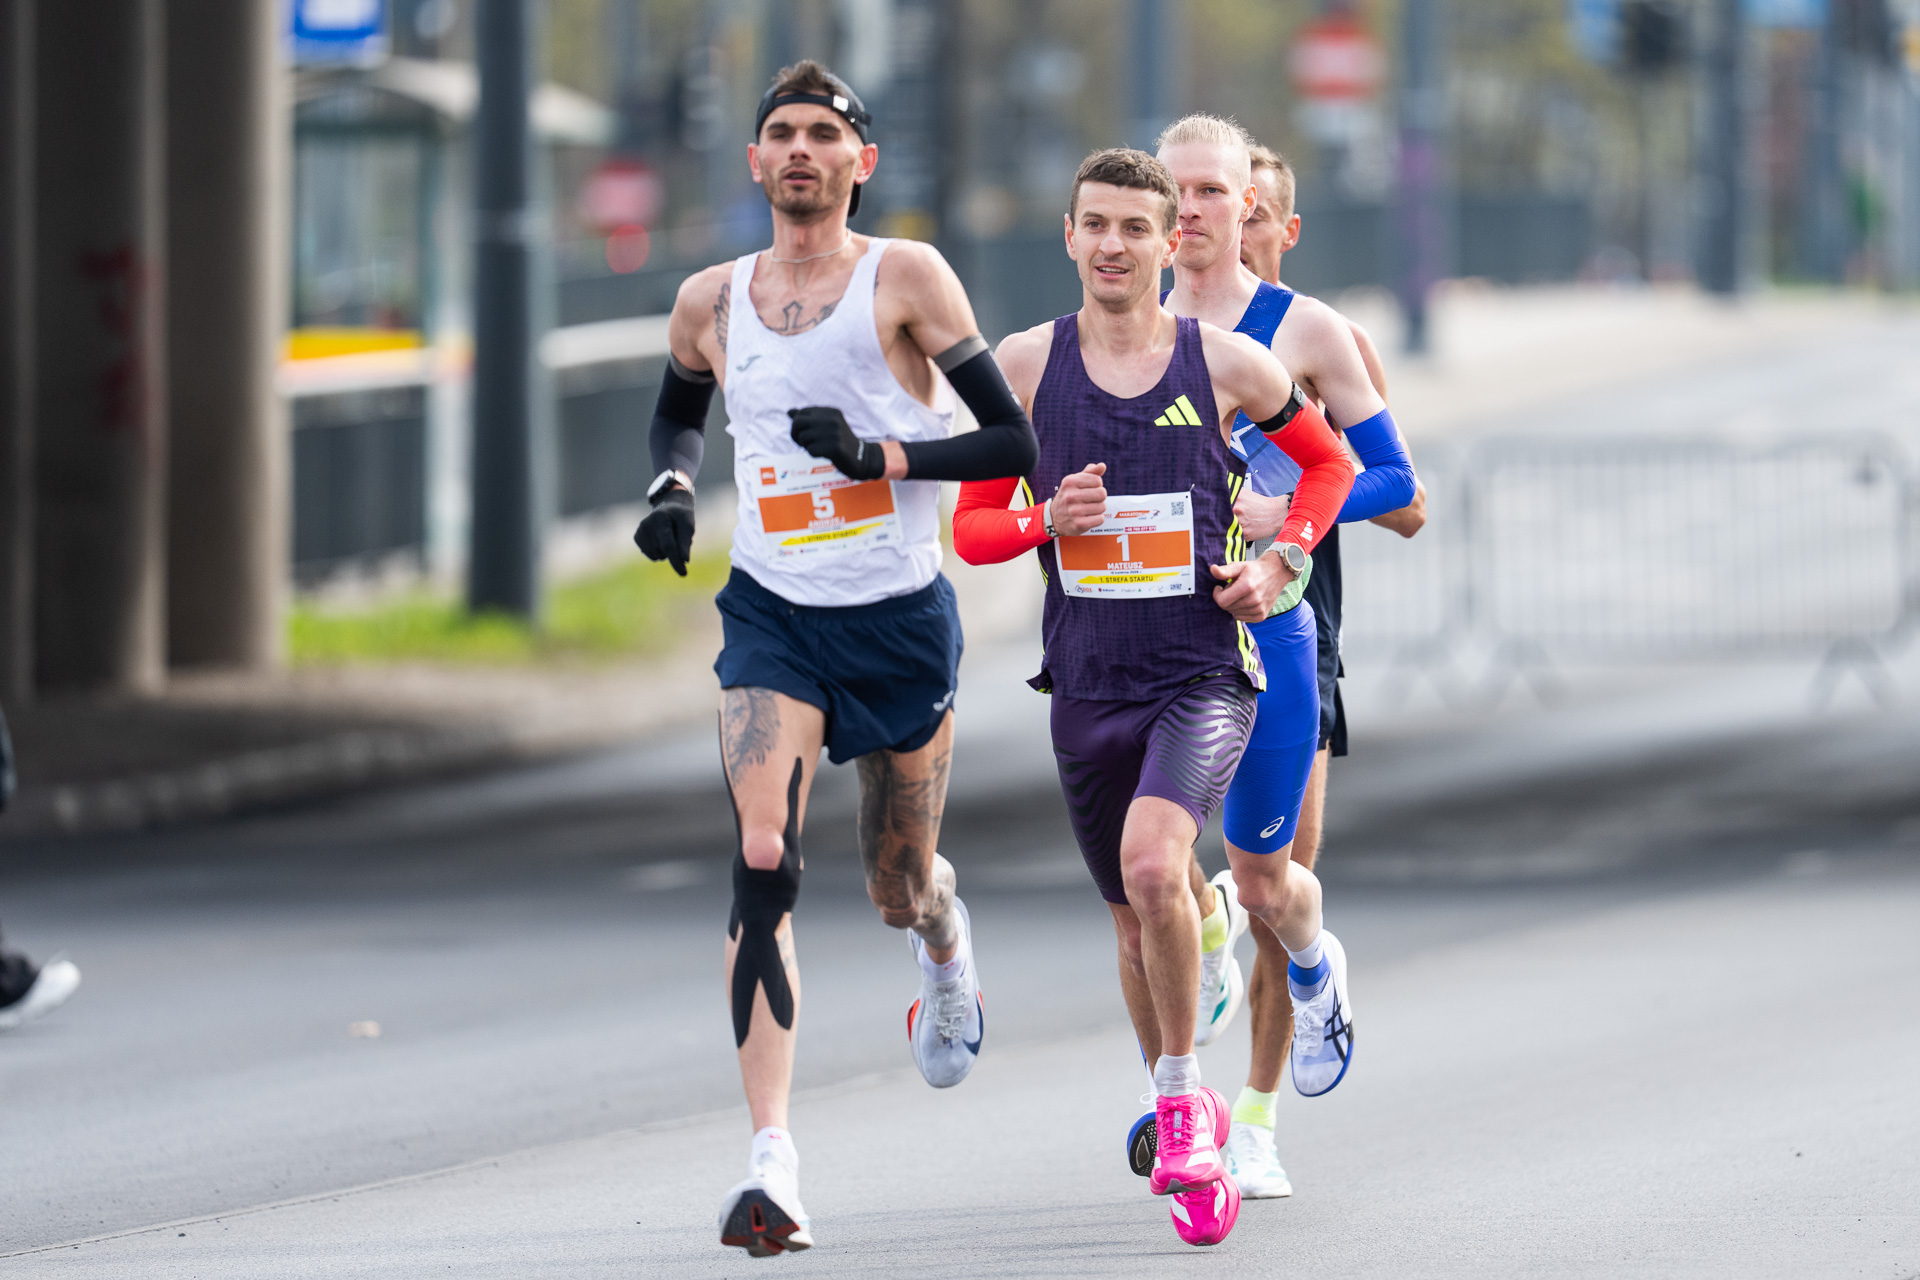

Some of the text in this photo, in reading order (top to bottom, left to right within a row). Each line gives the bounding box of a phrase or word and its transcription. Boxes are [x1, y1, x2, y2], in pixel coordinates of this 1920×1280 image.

[811, 490, 835, 519] 5
[1117, 534, 1130, 561] 1
[1107, 561, 1143, 570] MATEUSZ
